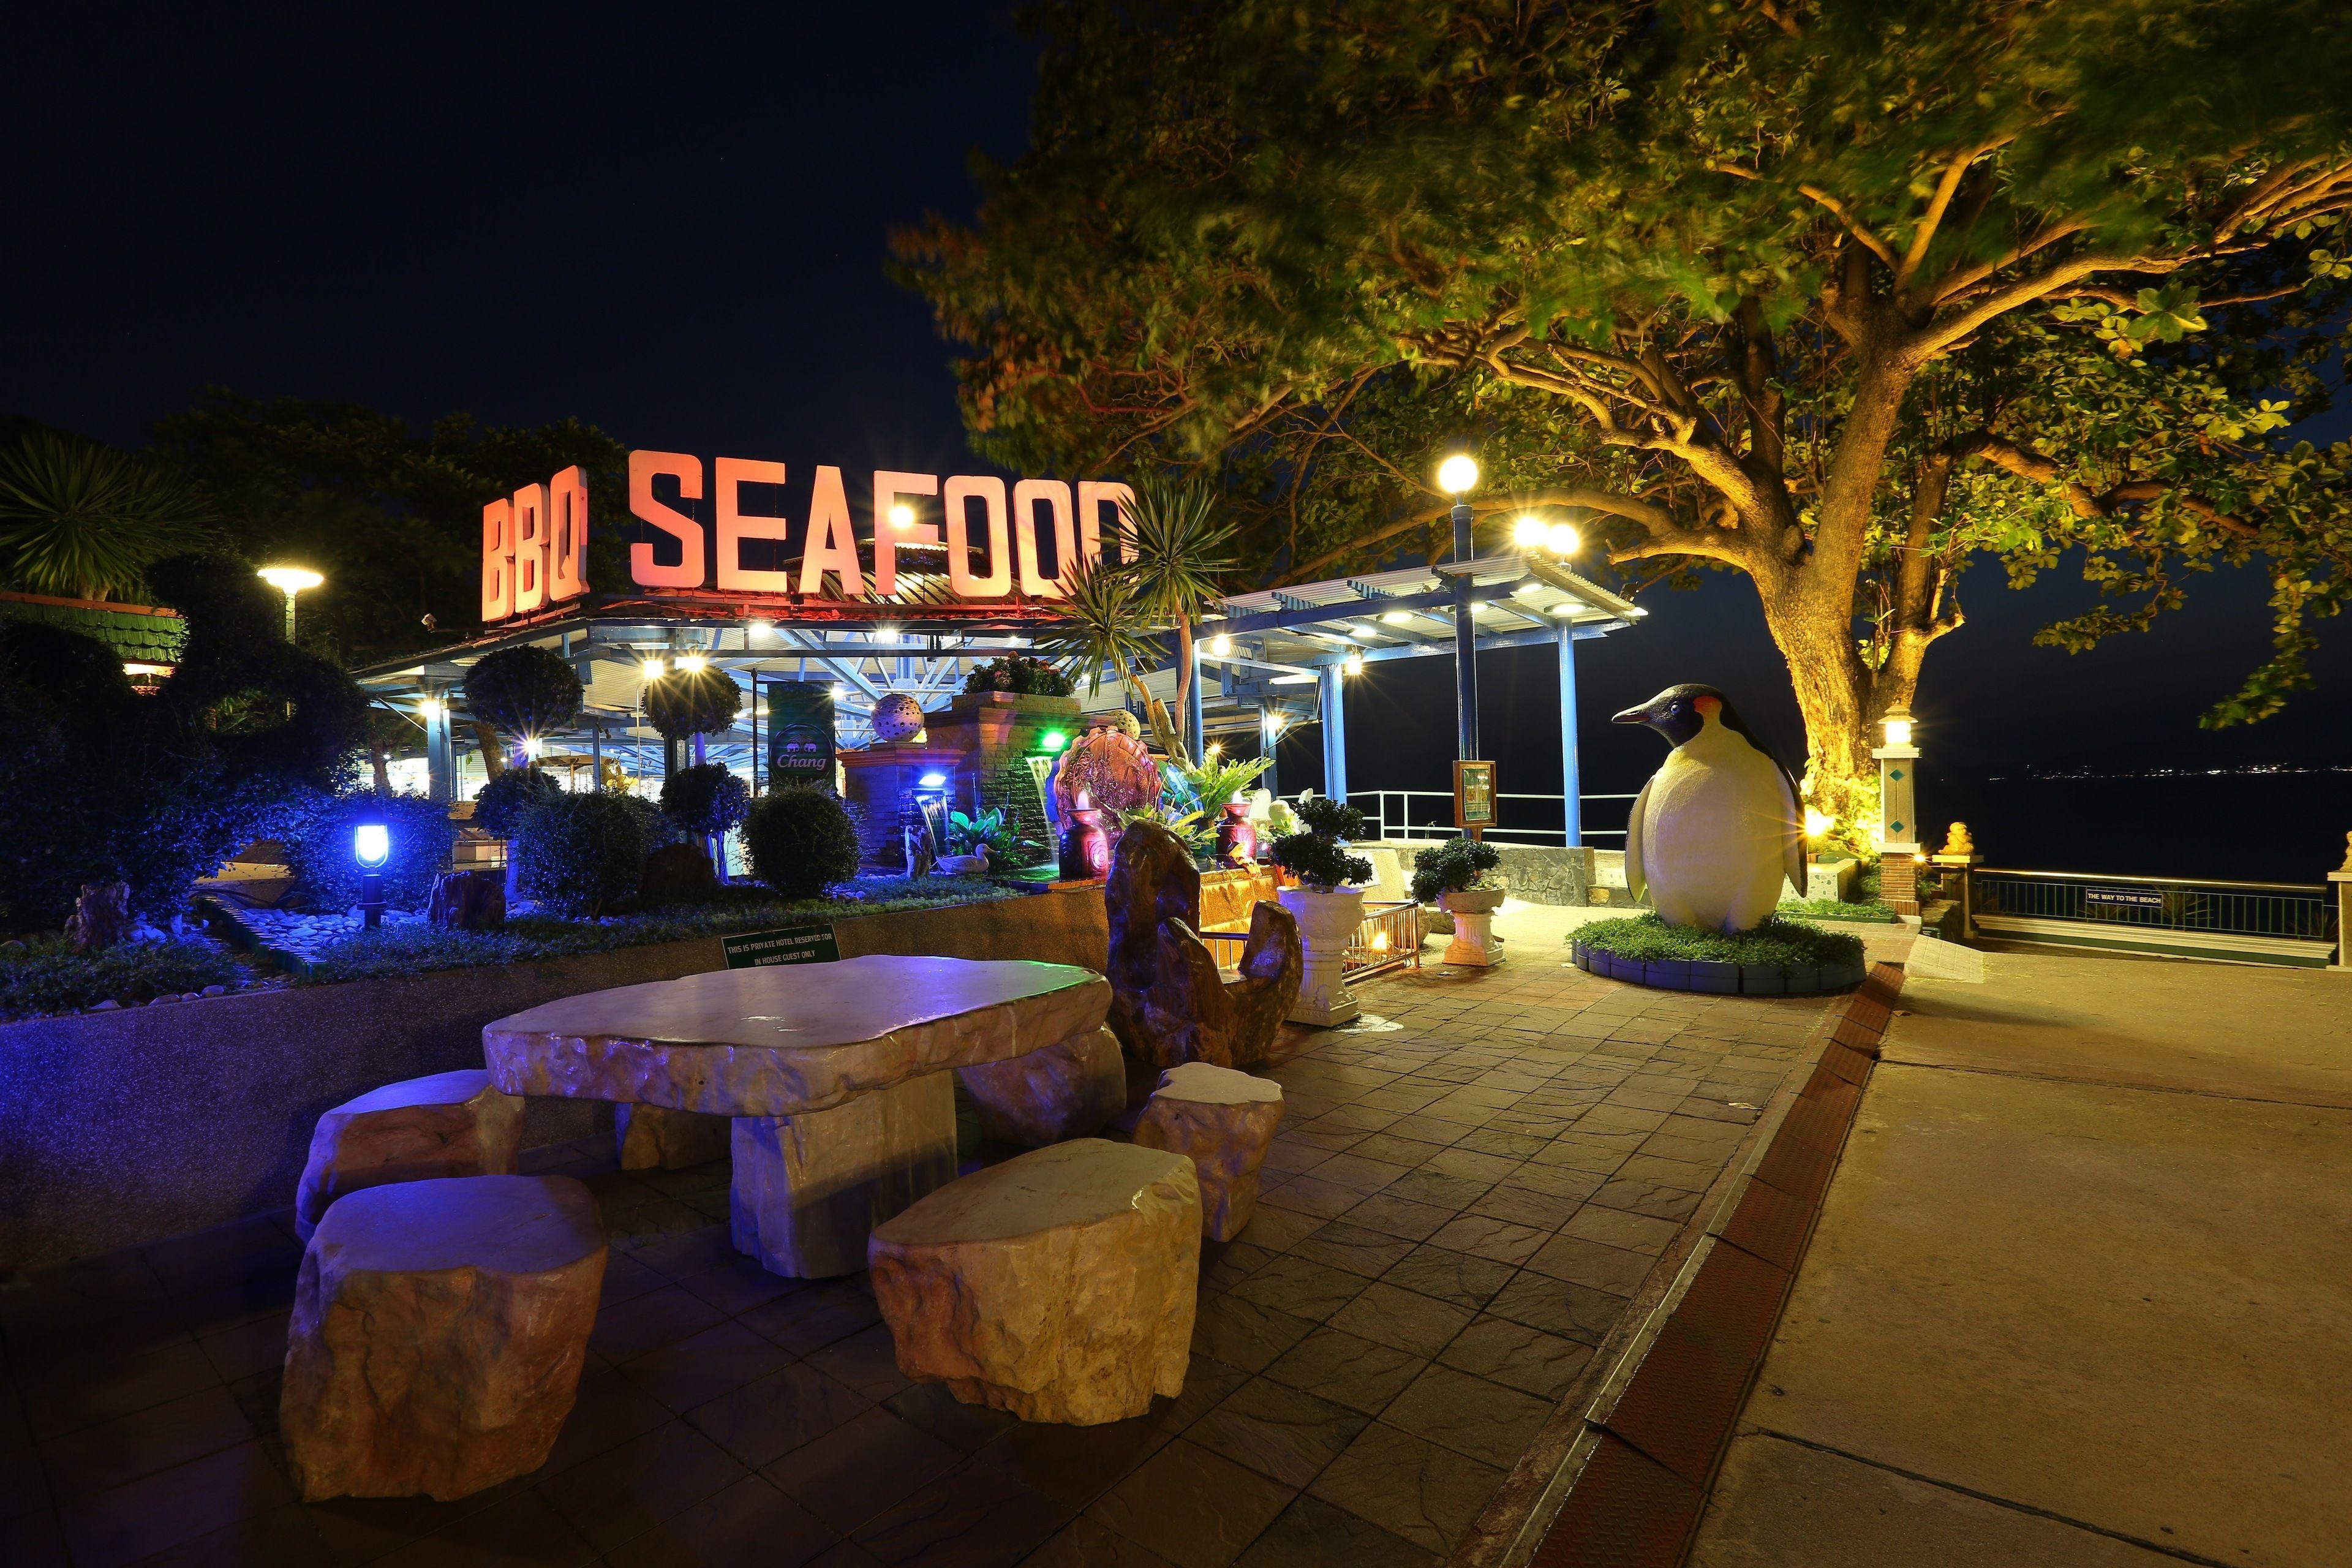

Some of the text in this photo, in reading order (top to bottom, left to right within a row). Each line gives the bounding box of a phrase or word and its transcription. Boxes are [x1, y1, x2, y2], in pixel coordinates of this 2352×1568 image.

[628, 449, 1140, 599] SEAFOOD
[481, 465, 590, 622] BBQ
[777, 754, 826, 771] Chang
[727, 946, 742, 954] THIS
[750, 941, 775, 951] PRIVATE
[776, 938, 794, 946] HOTEL
[794, 935, 821, 944] RESERVED
[762, 955, 782, 965] HOUSE
[801, 950, 815, 959] ONLY
